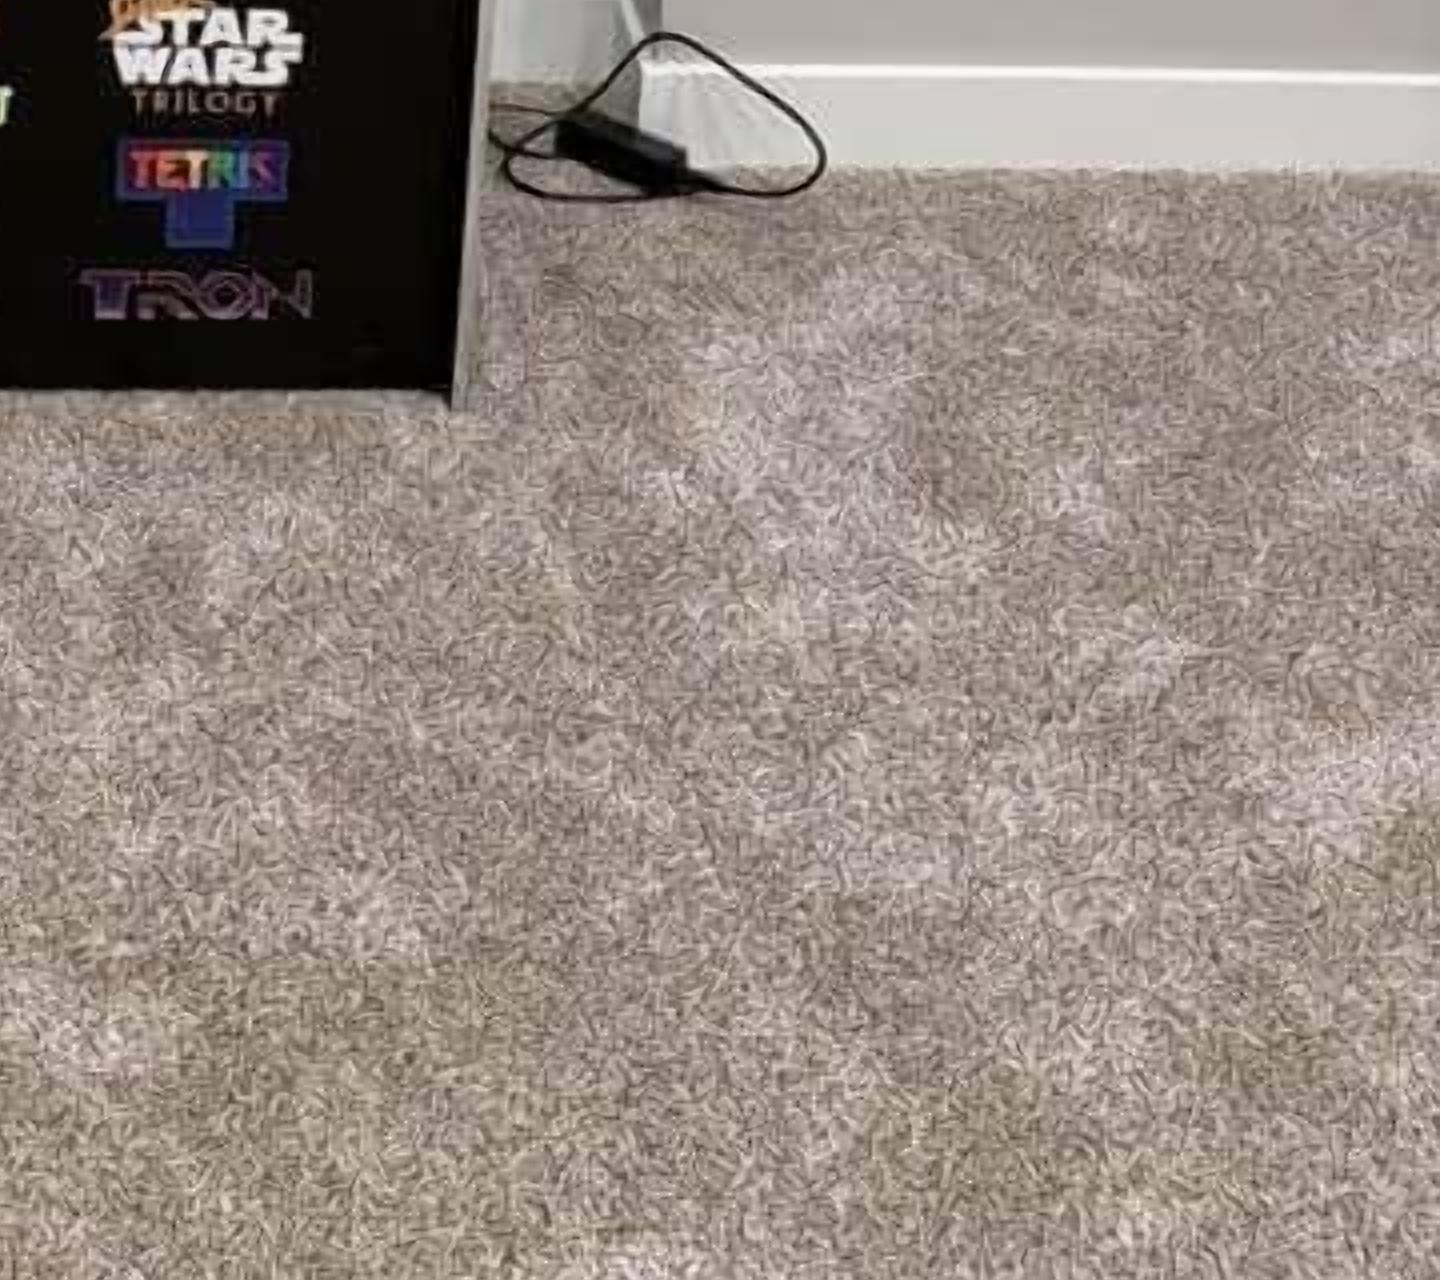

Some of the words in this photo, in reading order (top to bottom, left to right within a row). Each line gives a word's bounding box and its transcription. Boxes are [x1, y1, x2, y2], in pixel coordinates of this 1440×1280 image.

[111, 7, 304, 47] STAR
[113, 43, 304, 87] WARS
[129, 89, 284, 115] TRILOGY
[128, 149, 278, 190] TETRIS
[79, 269, 314, 321] TRON
